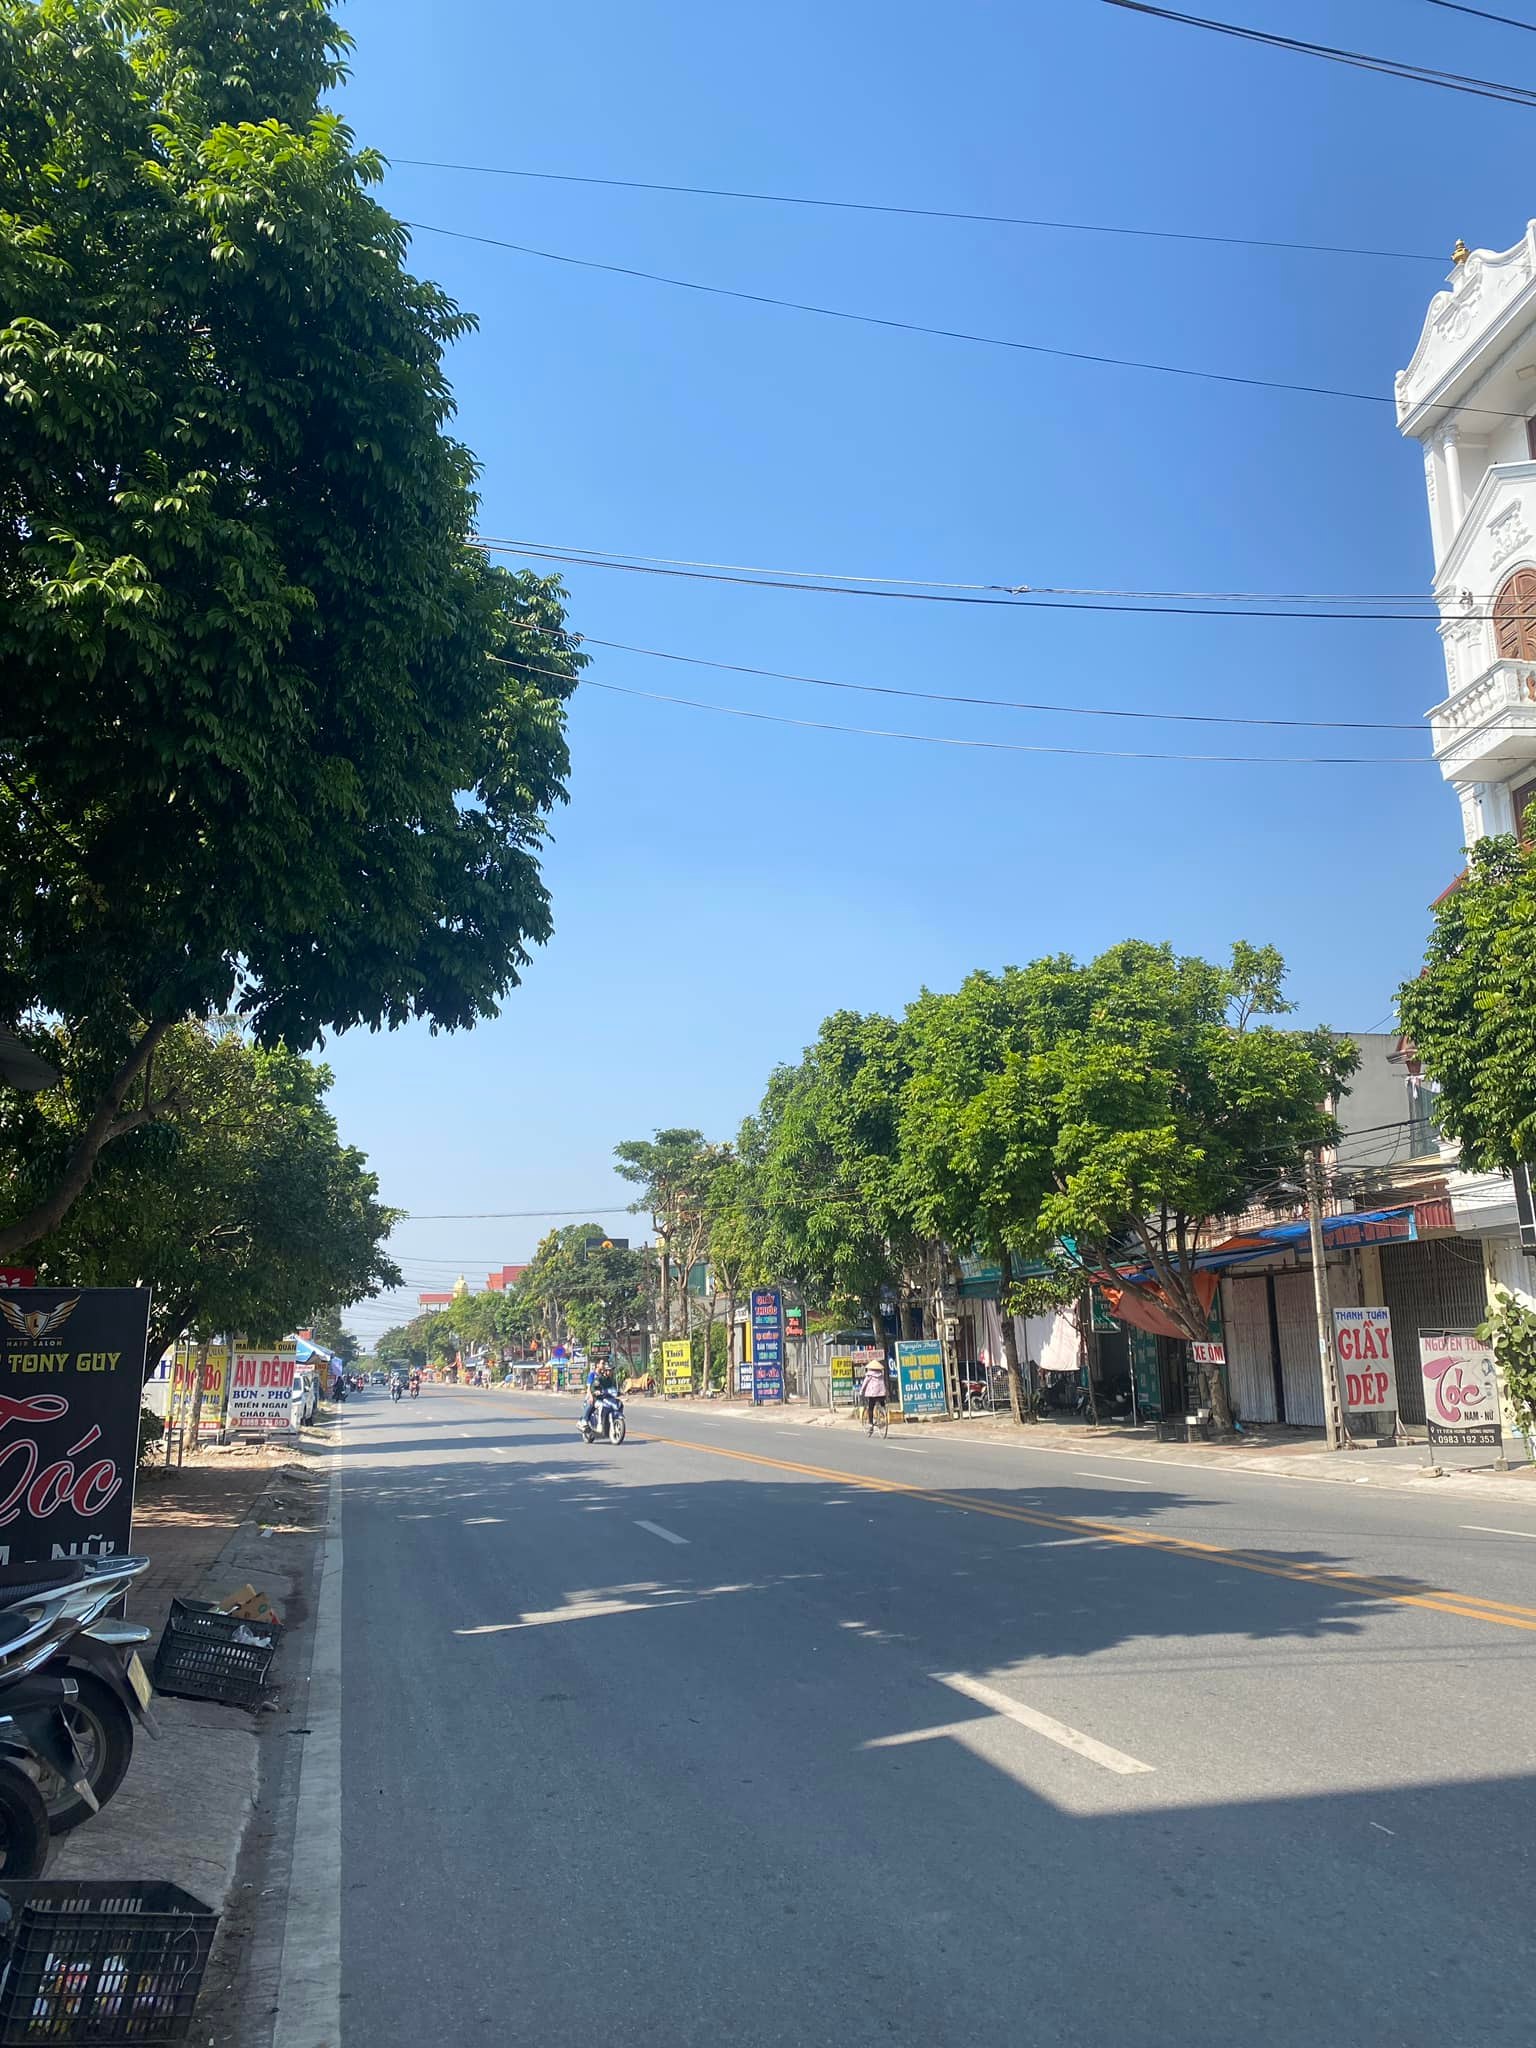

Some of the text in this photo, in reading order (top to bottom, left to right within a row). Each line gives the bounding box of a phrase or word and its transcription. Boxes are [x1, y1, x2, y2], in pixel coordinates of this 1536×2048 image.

[1336, 1312, 1363, 1320] THANH
[1194, 1343, 1224, 1360] XE ÔM
[8, 1352, 121, 1373] TONY GUY
[233, 1355, 296, 1387] ĂN ĐÊM
[1346, 1365, 1388, 1405] DÉP
[233, 1389, 258, 1399] BÚN
[1464, 1411, 1479, 1420] NAM
[1438, 1434, 1495, 1444] 0983 192 353
